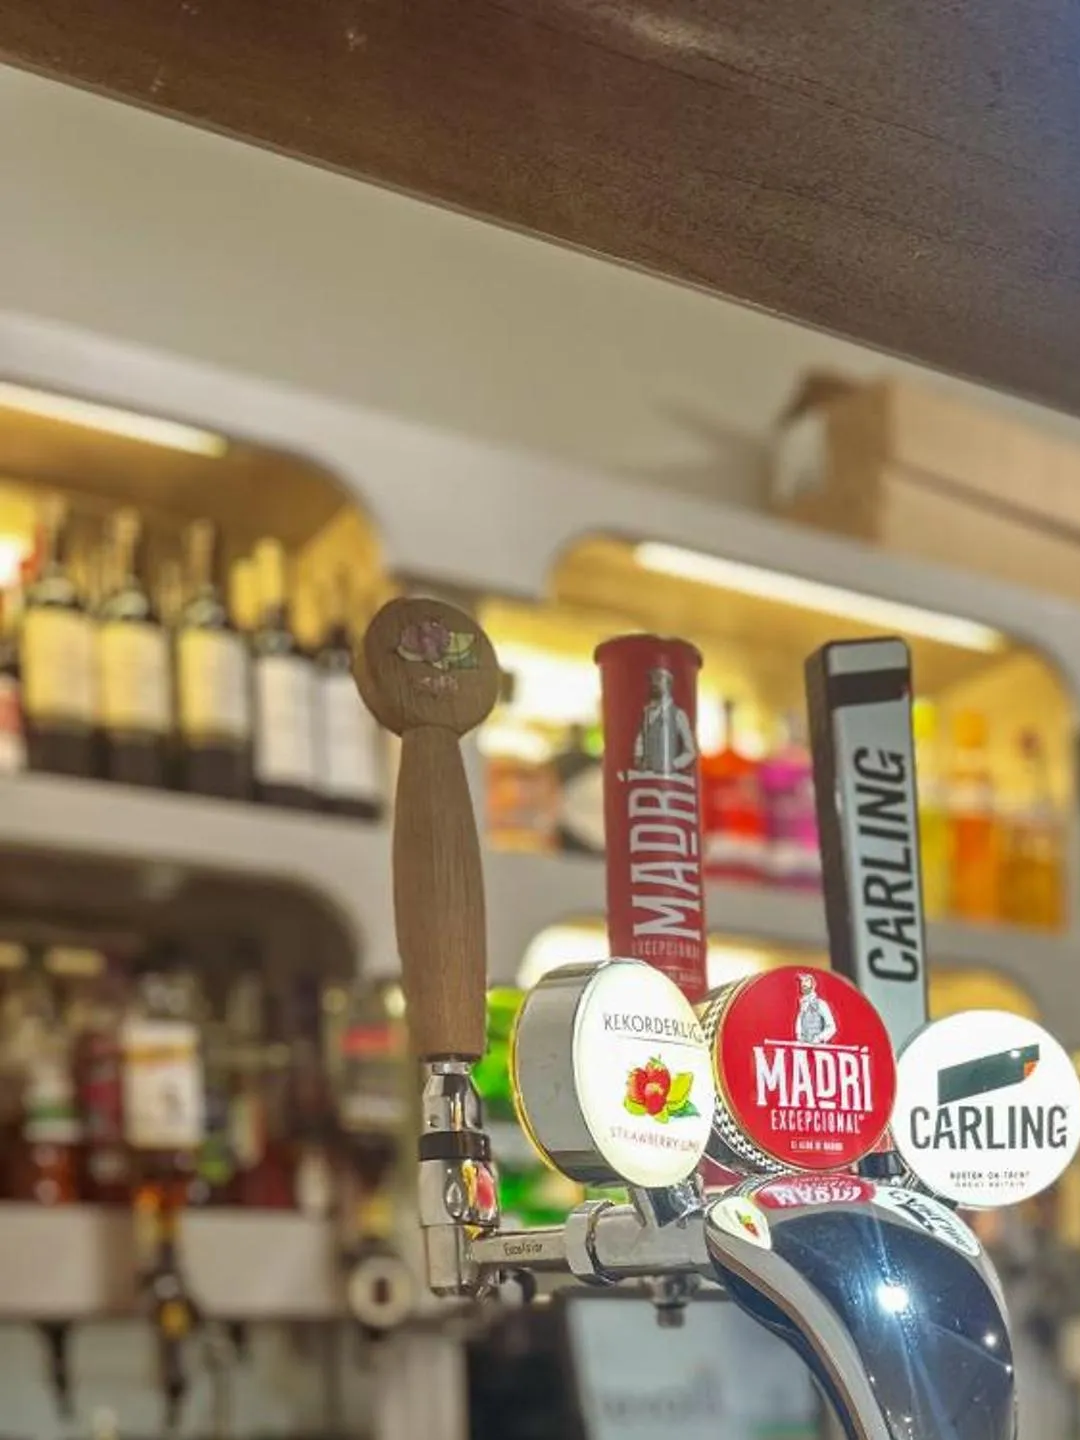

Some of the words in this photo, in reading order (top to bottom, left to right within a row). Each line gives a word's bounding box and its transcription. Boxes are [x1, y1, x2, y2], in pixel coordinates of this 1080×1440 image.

[853, 746, 919, 983] CARLING
[753, 1046, 873, 1112] MADRÍ
[770, 1108, 861, 1134] EXCEPCIONAL
[910, 1105, 1068, 1150] CARLING
